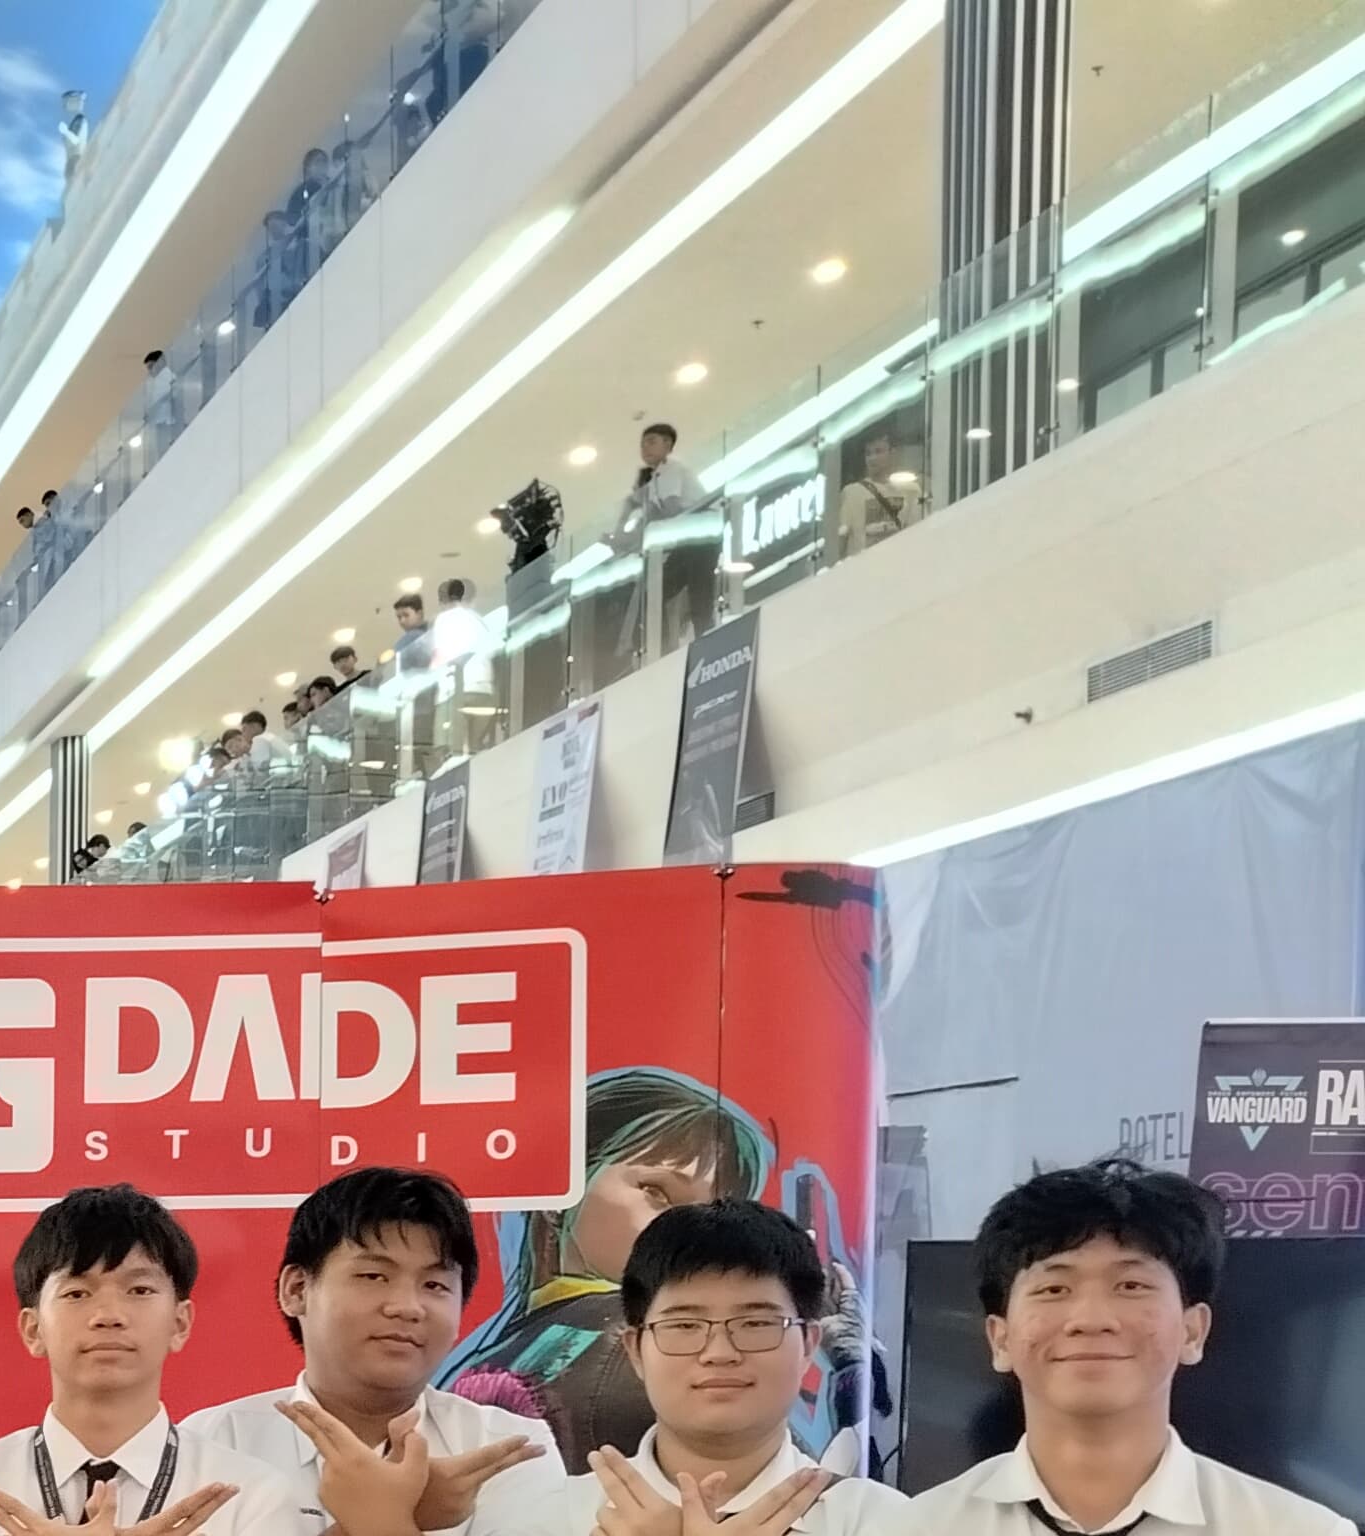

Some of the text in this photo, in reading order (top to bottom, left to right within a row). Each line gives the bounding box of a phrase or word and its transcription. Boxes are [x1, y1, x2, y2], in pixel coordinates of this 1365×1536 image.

[700, 646, 752, 685] HONDA
[84, 971, 517, 1109] DADE
[1207, 1096, 1309, 1124] VANGUARD
[84, 1127, 518, 1165] STUDIO
